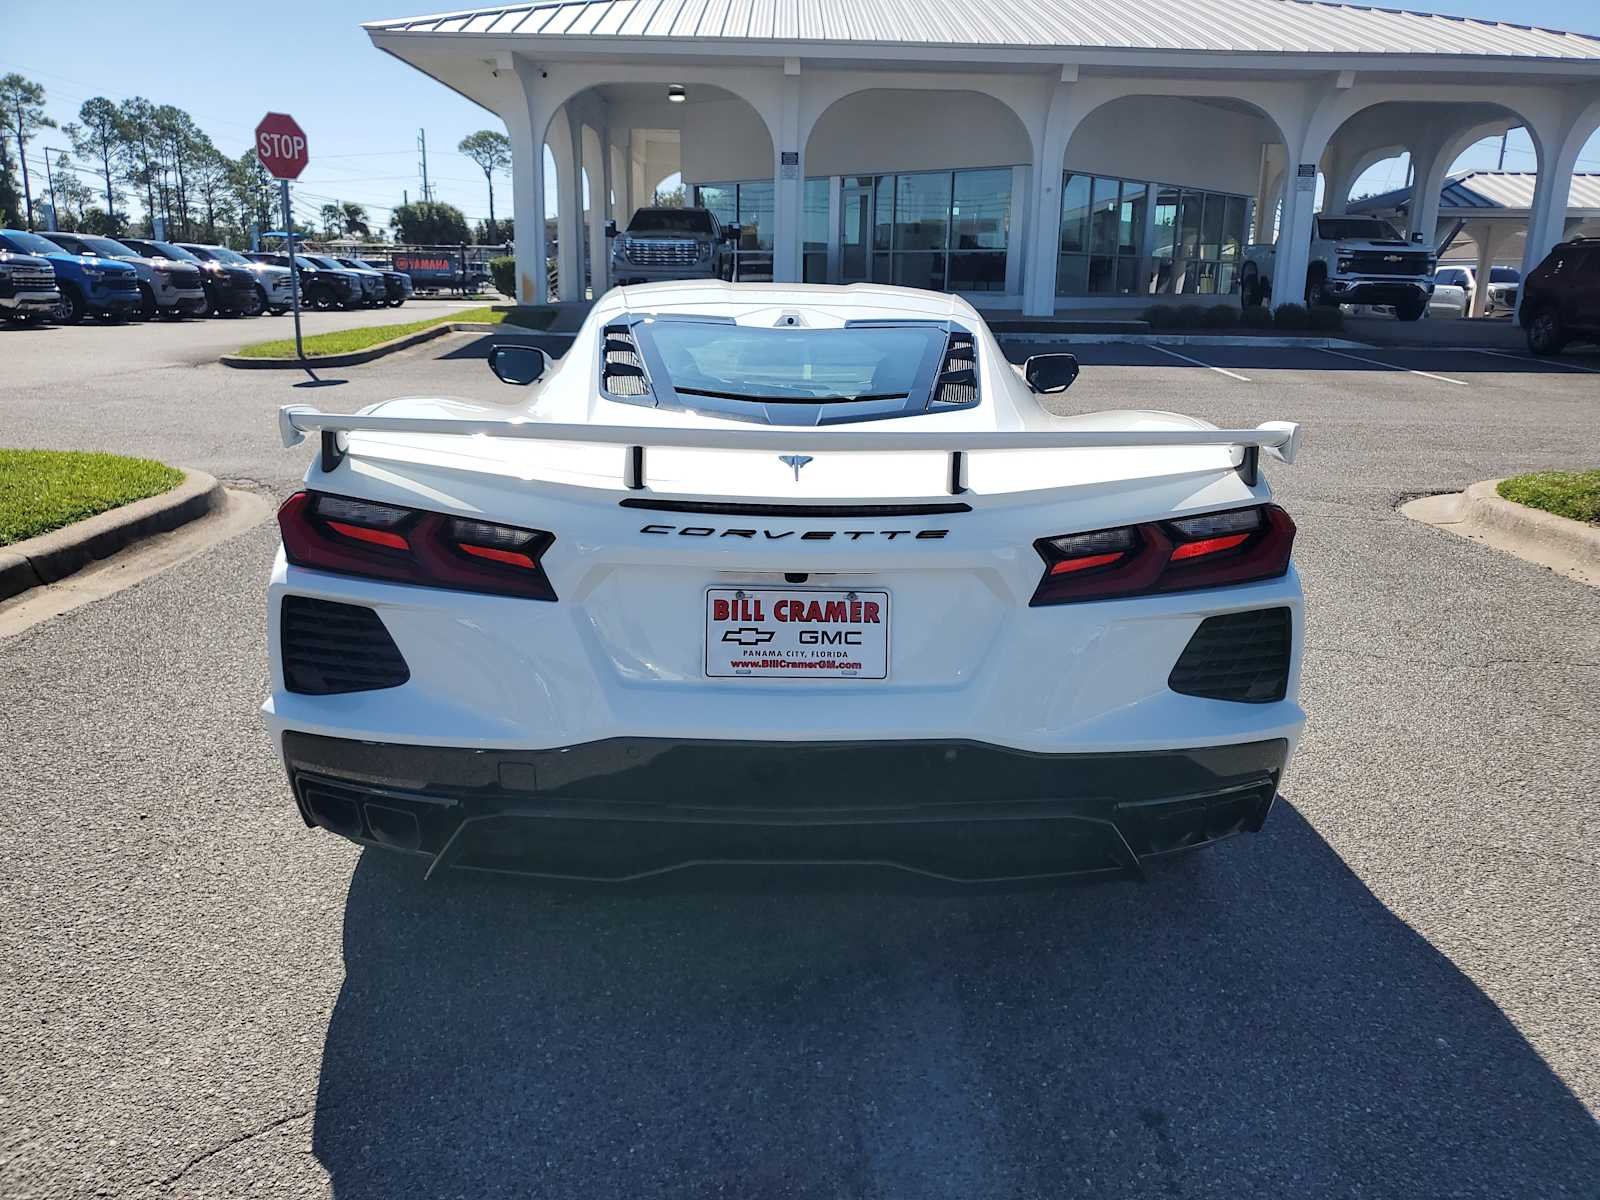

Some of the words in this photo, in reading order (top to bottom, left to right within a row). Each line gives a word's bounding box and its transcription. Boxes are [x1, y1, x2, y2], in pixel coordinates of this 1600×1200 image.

[260, 132, 305, 160] STOP
[409, 259, 449, 270] YAMAHA
[640, 525, 950, 540] CORVETTE
[713, 599, 765, 622] BILL
[773, 599, 881, 624] CRAMER
[800, 630, 862, 645] GMC
[786, 650, 807, 659] CITY,
[811, 651, 848, 659] FLORIDA
[730, 659, 862, 670] www.BillCramerGM.com
